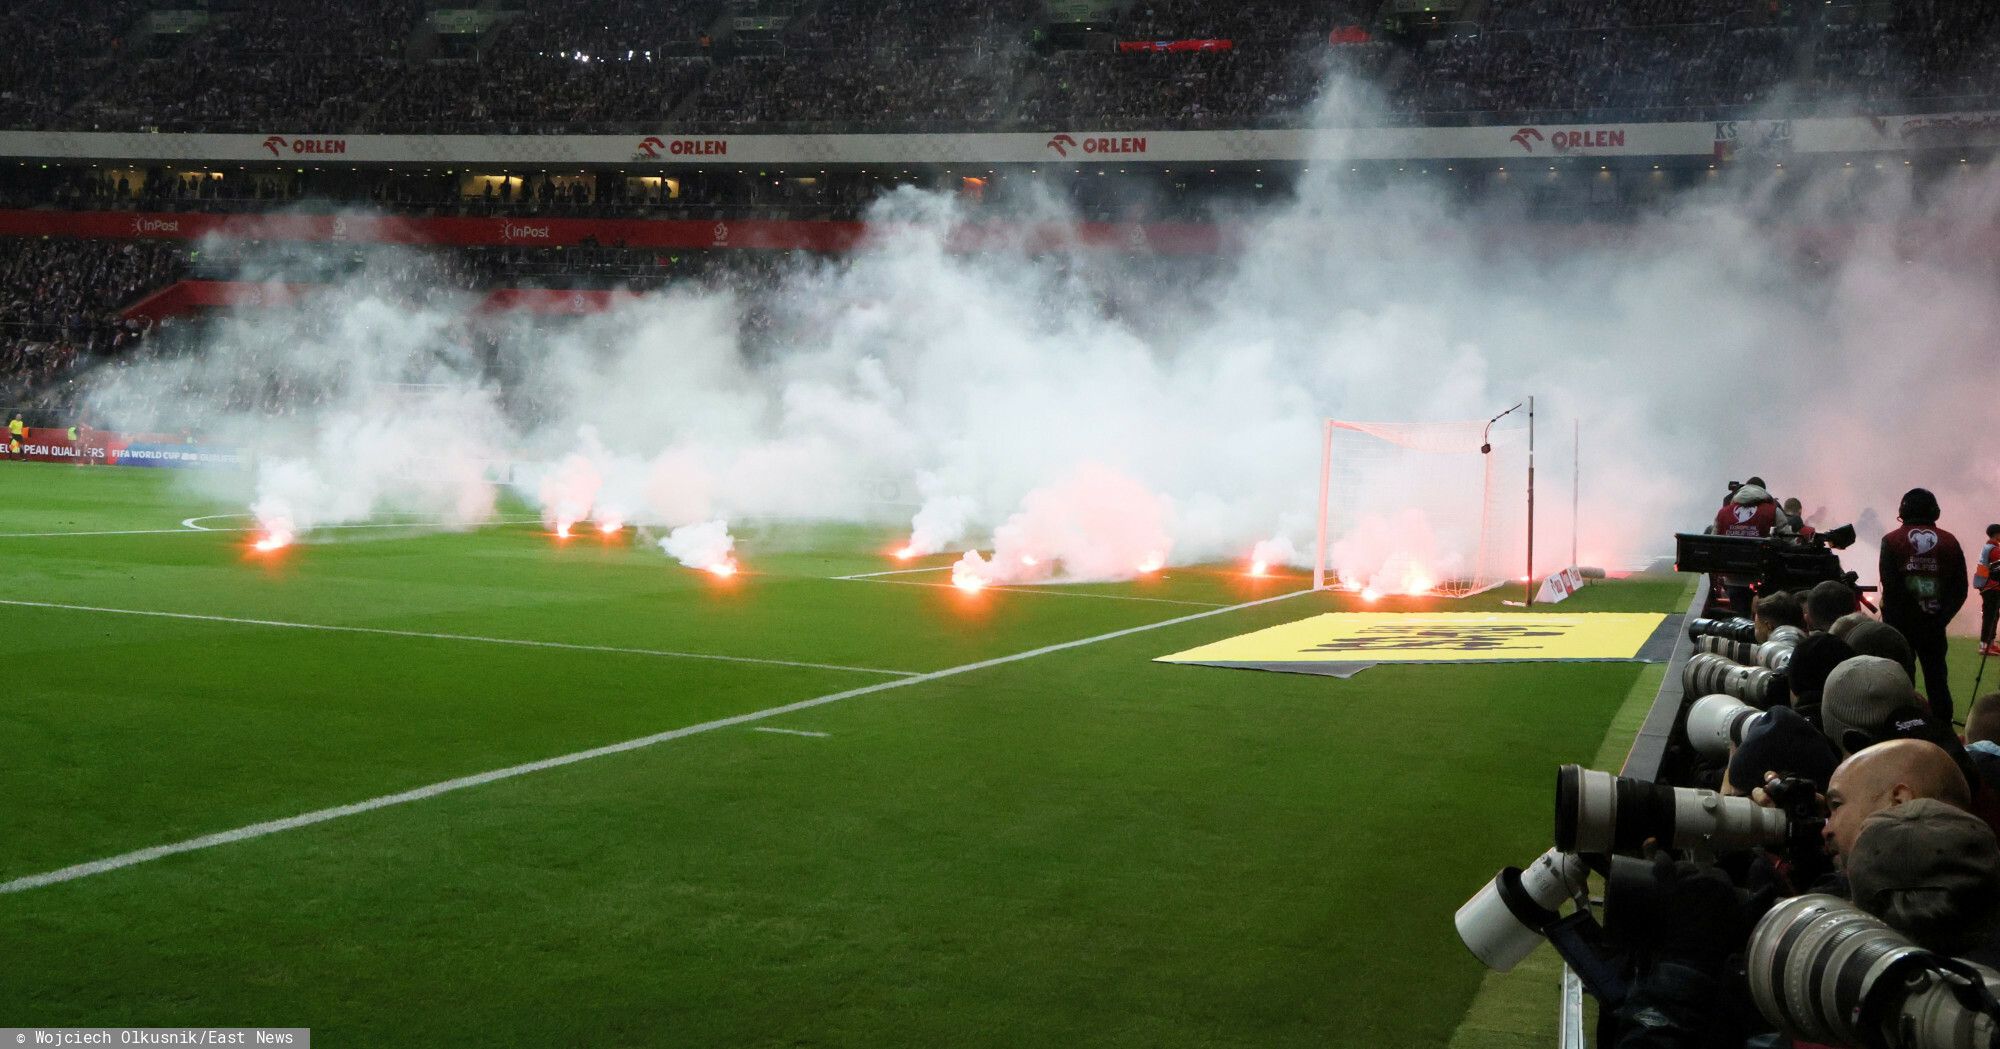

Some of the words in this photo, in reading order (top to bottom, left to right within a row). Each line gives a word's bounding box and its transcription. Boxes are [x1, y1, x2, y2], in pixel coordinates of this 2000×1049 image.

[293, 139, 346, 154] ORLEN
[1083, 138, 1147, 154] ORLEN
[1552, 130, 1625, 148] ORLEN
[670, 140, 727, 155] ORLEN
[112, 449, 130, 459] FIFA
[131, 451, 162, 460] WORLD
[163, 452, 181, 460] CUP
[1895, 719, 1925, 731] Supreme
